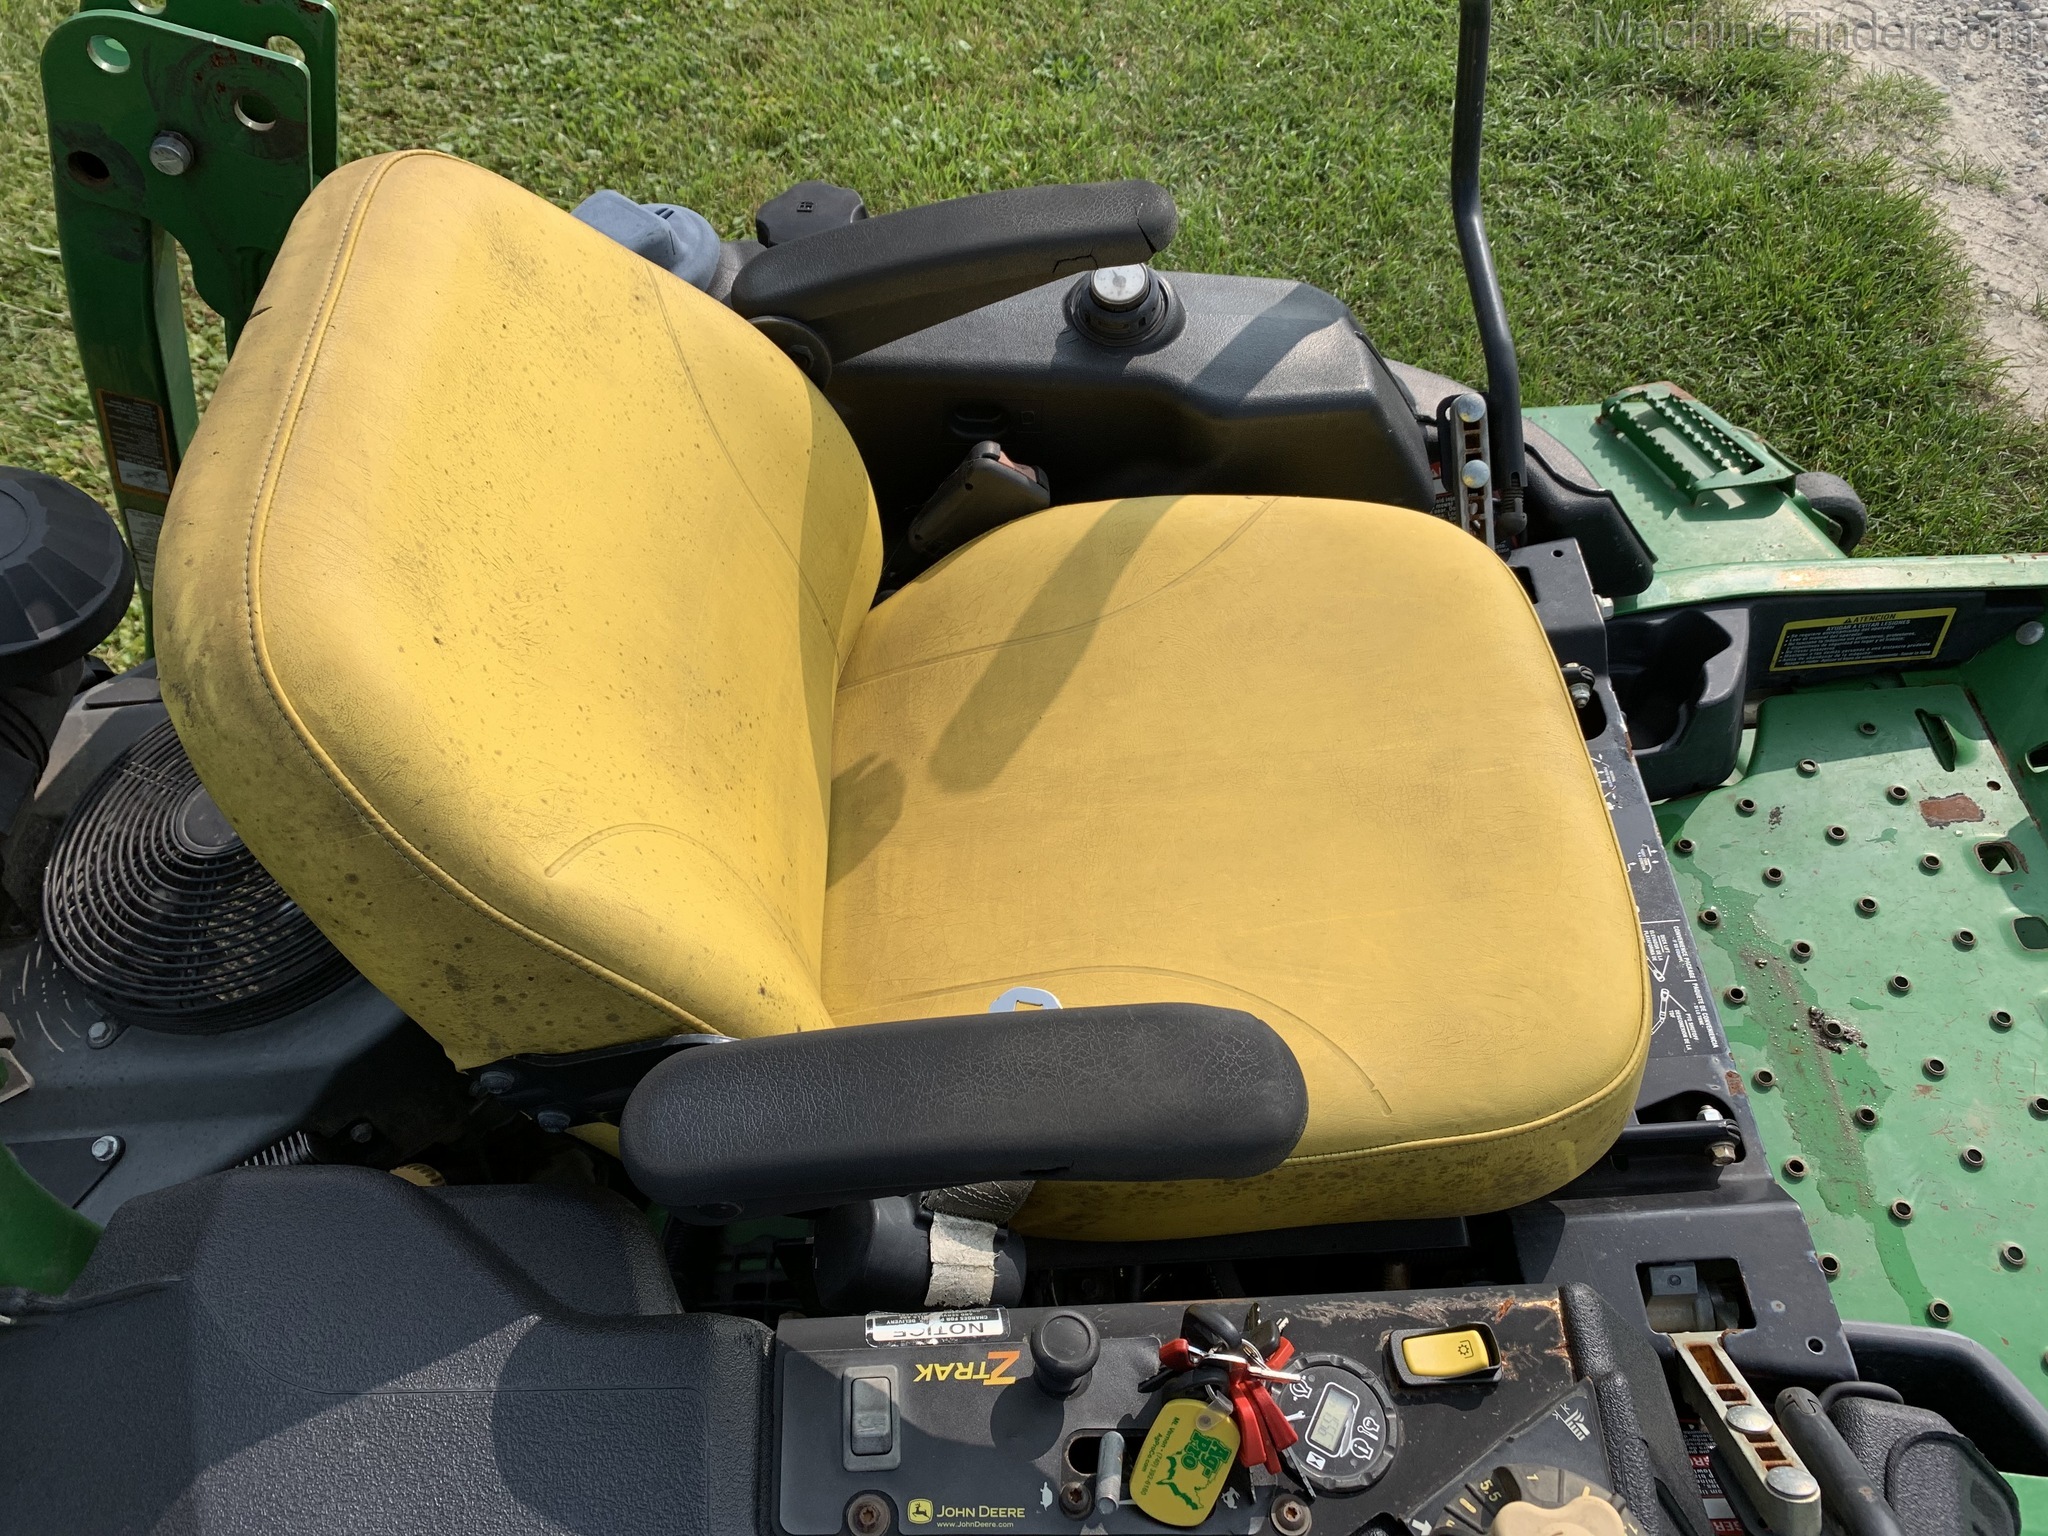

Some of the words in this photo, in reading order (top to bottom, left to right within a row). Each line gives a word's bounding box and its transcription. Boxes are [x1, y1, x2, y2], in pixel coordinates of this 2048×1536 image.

[1162, 1427, 1175, 1448] Vernon
[1142, 1433, 1163, 1472] AgProCo.com
[937, 1505, 975, 1518] JOHN
[979, 1505, 1025, 1518] DEERE
